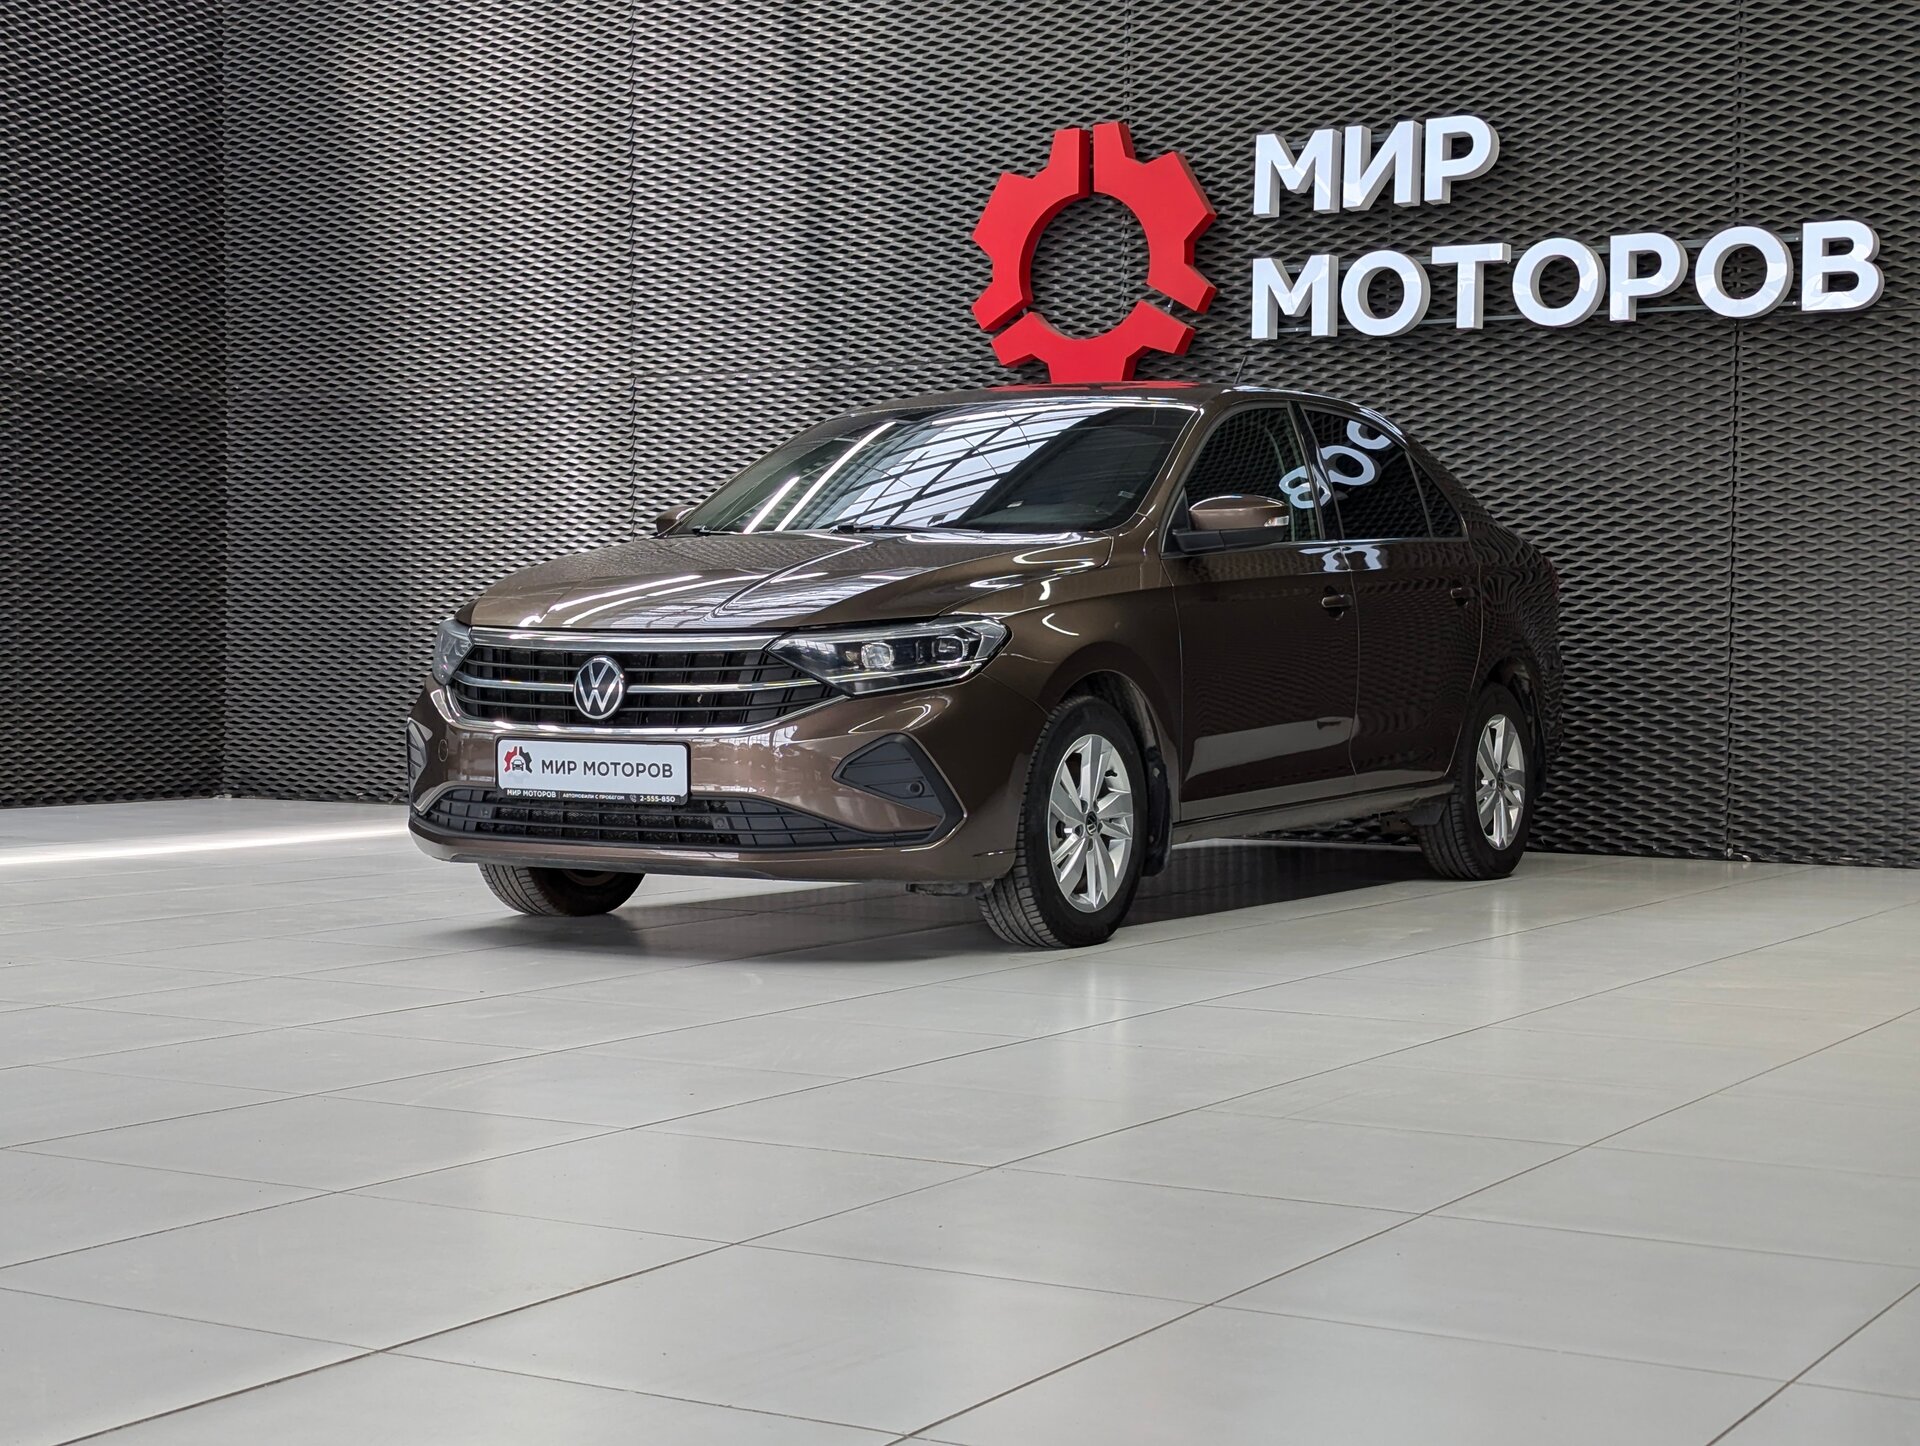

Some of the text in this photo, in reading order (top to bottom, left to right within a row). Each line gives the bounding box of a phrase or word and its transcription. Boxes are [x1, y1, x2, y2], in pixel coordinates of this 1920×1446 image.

[1253, 114, 1500, 218] МИР
[1251, 219, 1884, 340] МОТОРОВ
[523, 790, 557, 798] МОТОРОВ
[639, 795, 676, 803] 2-555-850
[541, 760, 673, 778] МИР МОТОРОВ
